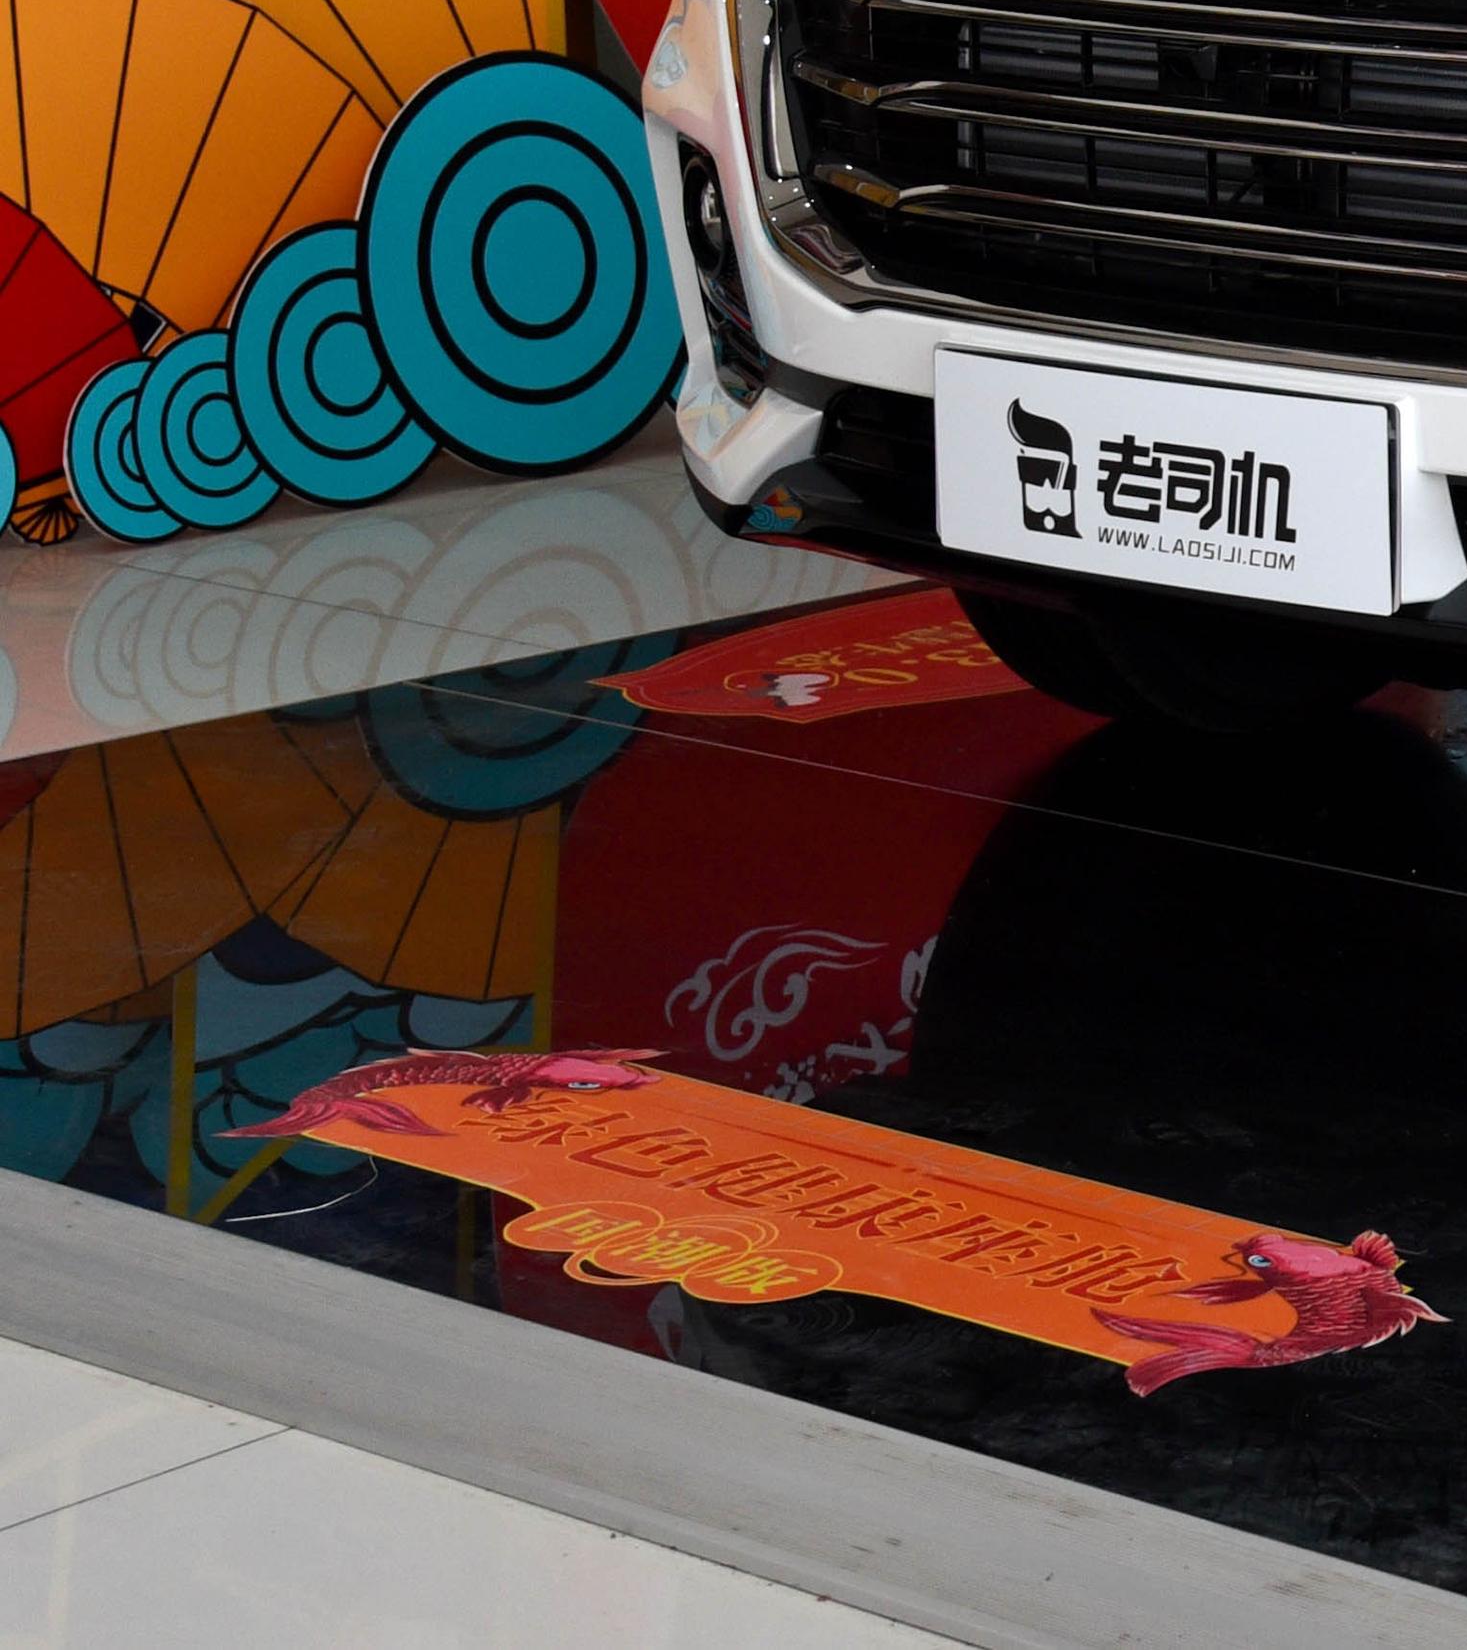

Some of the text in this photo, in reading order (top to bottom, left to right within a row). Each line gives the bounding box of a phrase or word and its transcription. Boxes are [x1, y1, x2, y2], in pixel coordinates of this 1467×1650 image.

[1097, 434, 1297, 544] 老司机
[1098, 525, 1296, 572] WWW.LAOSIJI.COM
[524, 1208, 818, 1294] 国潮版
